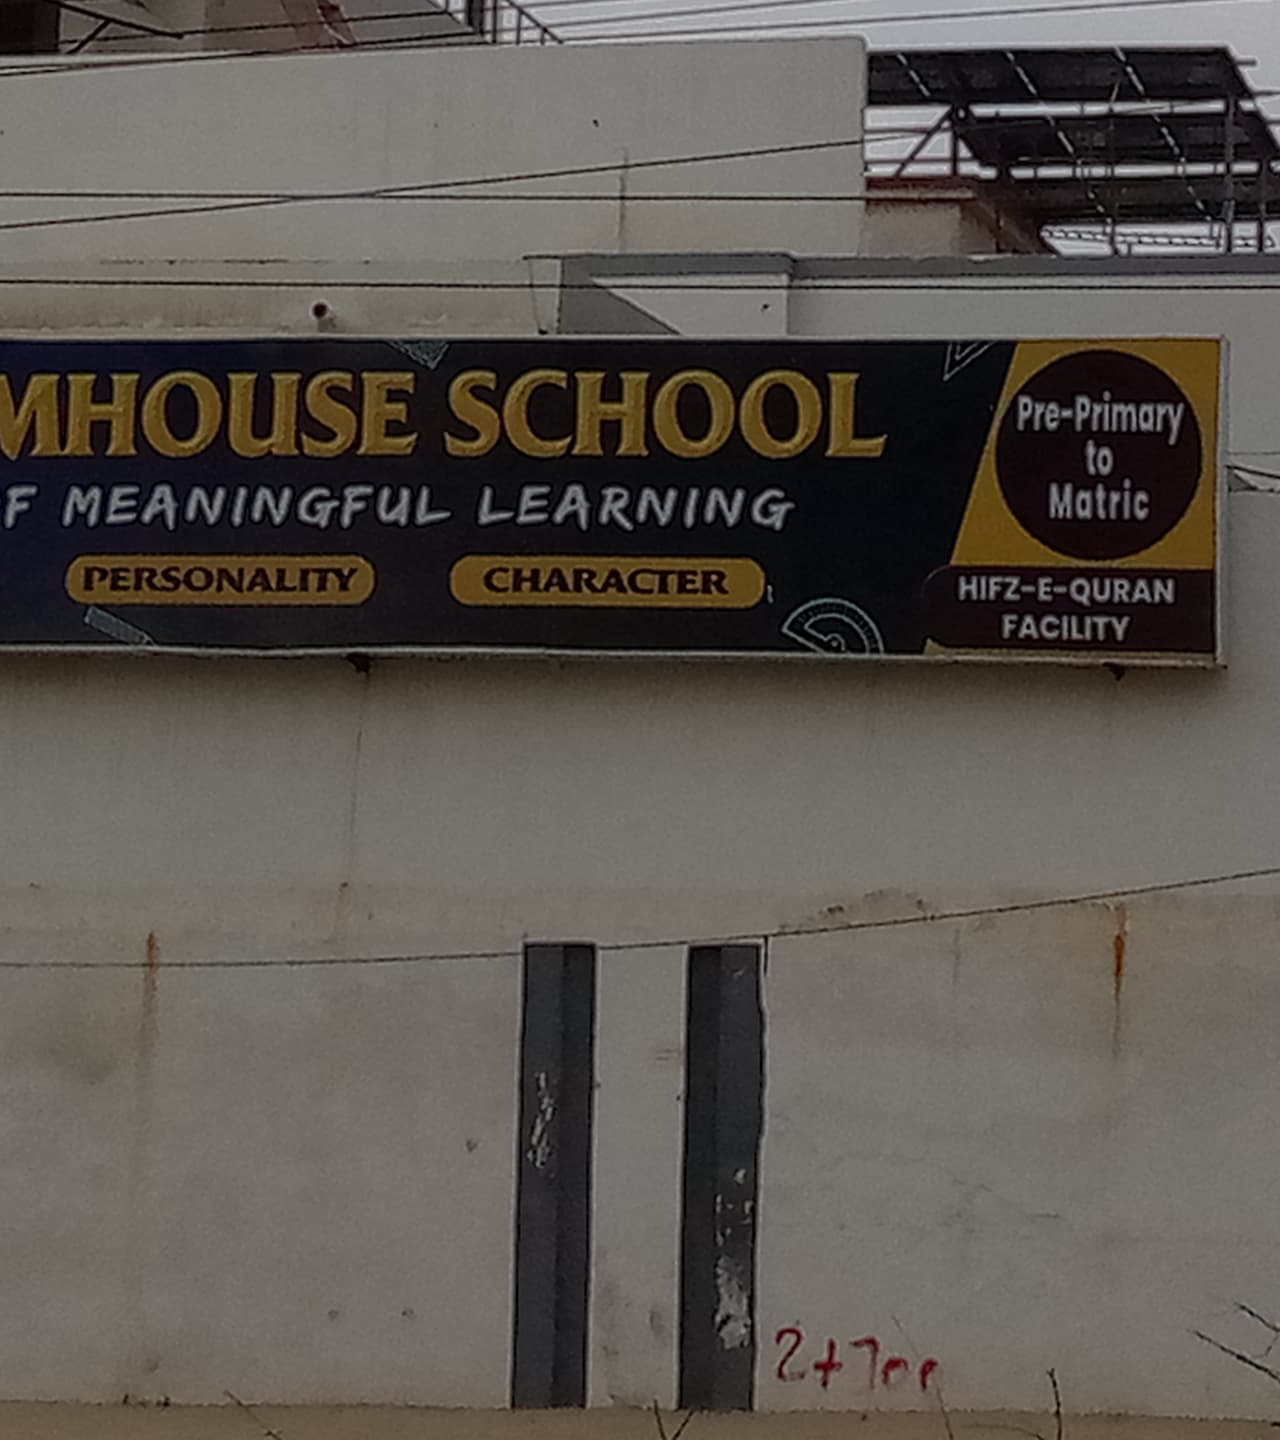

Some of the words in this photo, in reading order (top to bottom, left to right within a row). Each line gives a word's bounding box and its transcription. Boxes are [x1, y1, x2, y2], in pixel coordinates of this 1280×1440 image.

[443, 370, 888, 459] SCHOOL
[1015, 390, 1185, 445] Pre-Primary
[1085, 439, 1114, 476] to
[61, 482, 452, 531] MEANINGFUL
[476, 482, 796, 532] LEARNING
[1048, 478, 1150, 521] Matric
[81, 564, 360, 595] PERSONALITY
[482, 566, 730, 596] CHARACTER
[958, 574, 1176, 606] HIFZ-E-QURAN
[1001, 613, 1131, 642] FACILITY
